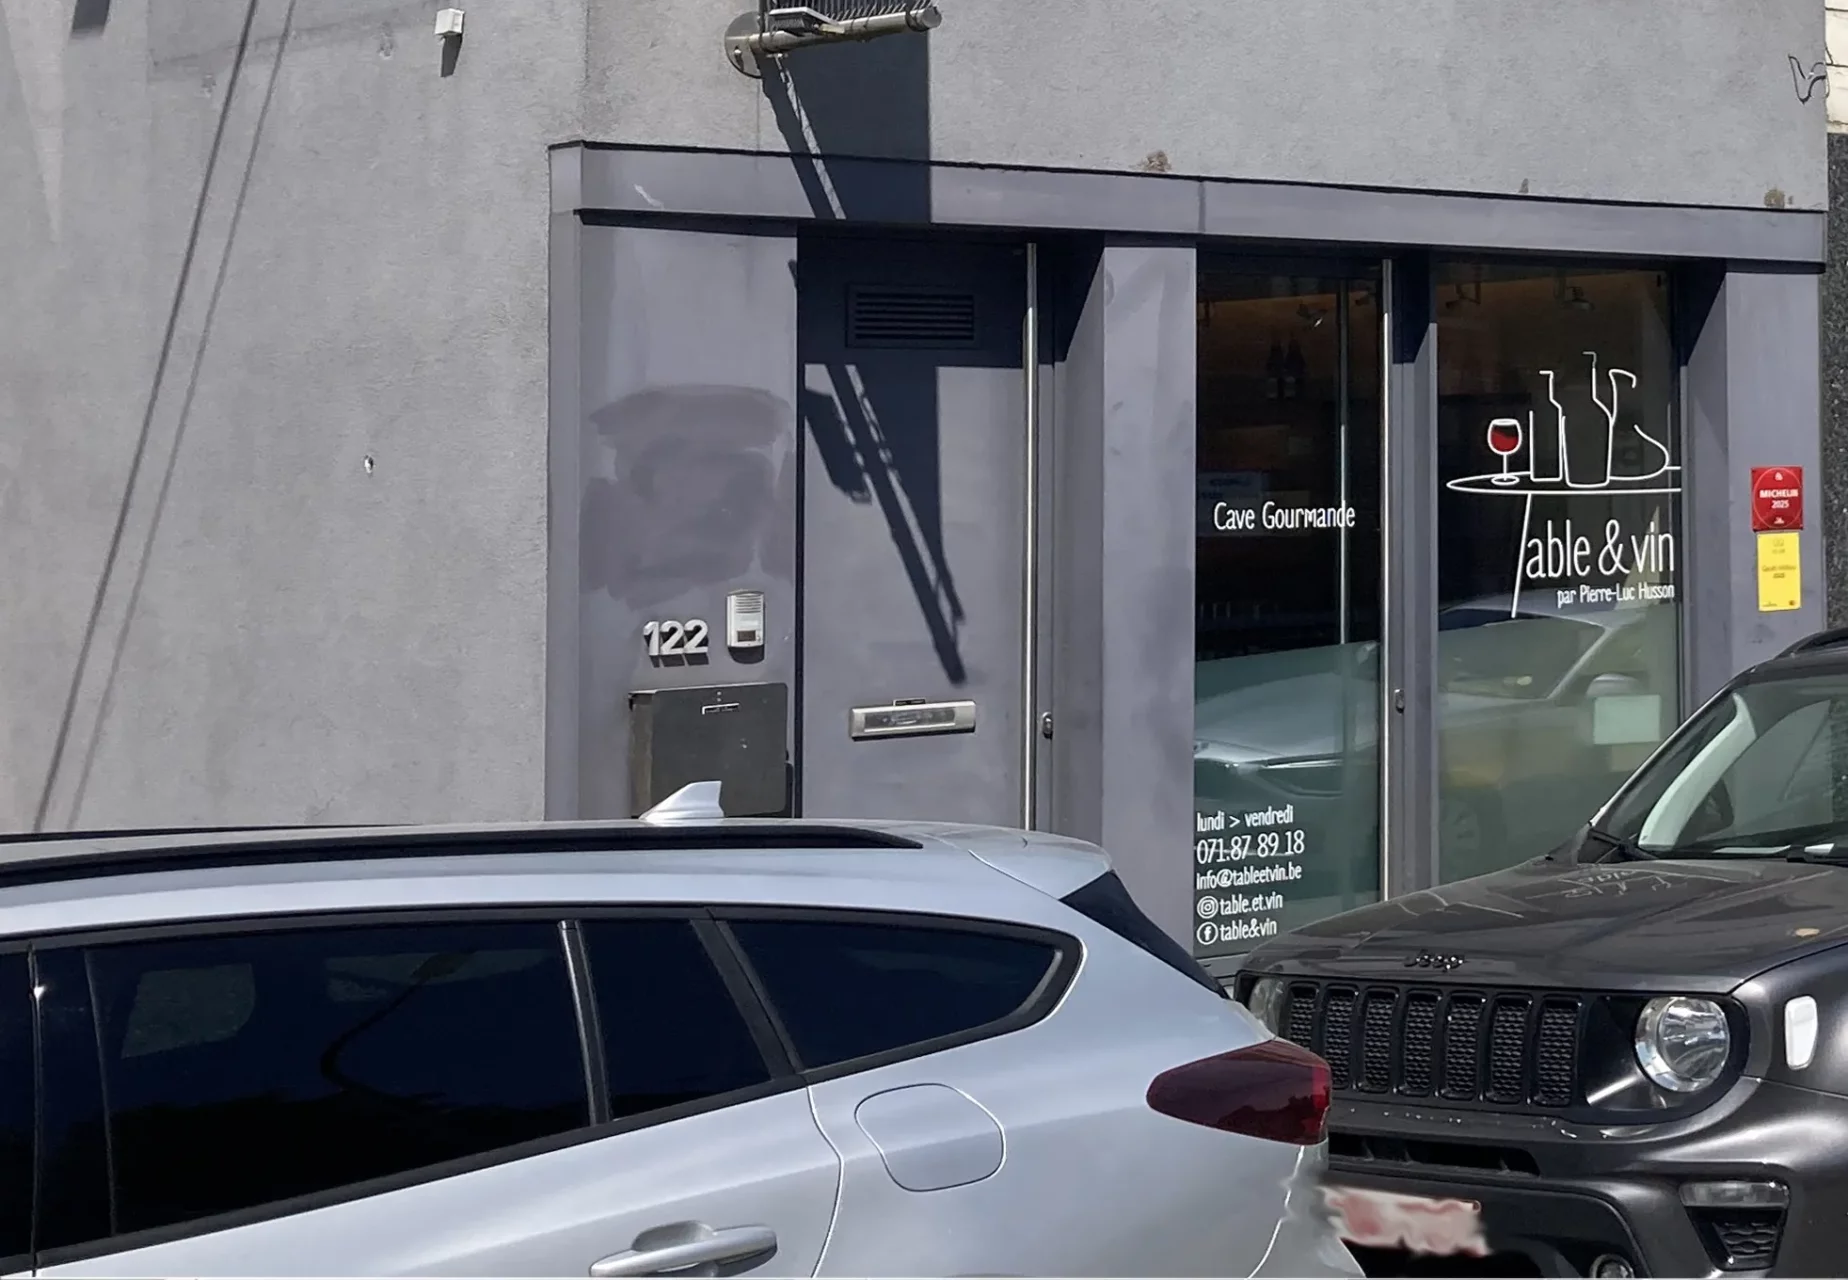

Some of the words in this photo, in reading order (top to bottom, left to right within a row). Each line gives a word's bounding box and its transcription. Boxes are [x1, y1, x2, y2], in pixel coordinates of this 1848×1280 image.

[1759, 489, 1799, 499] MICHELIN
[1214, 502, 1255, 530] Cave
[1262, 499, 1356, 529] Gourmande
[1598, 519, 1631, 576] &
[1631, 520, 1675, 573] vin
[1557, 590, 1576, 608] par
[1580, 583, 1635, 603] Pierre-Luc
[1638, 581, 1675, 600] Husson
[643, 618, 709, 657] 122
[1196, 810, 1225, 832] lundi
[1244, 803, 1294, 828] vendredi
[1257, 832, 1280, 858] 89
[1285, 829, 1306, 856] 18
[1196, 861, 1302, 891] info@tableetvin.be
[1219, 891, 1284, 916] table.et.vin
[1219, 918, 1277, 942] table&vin
